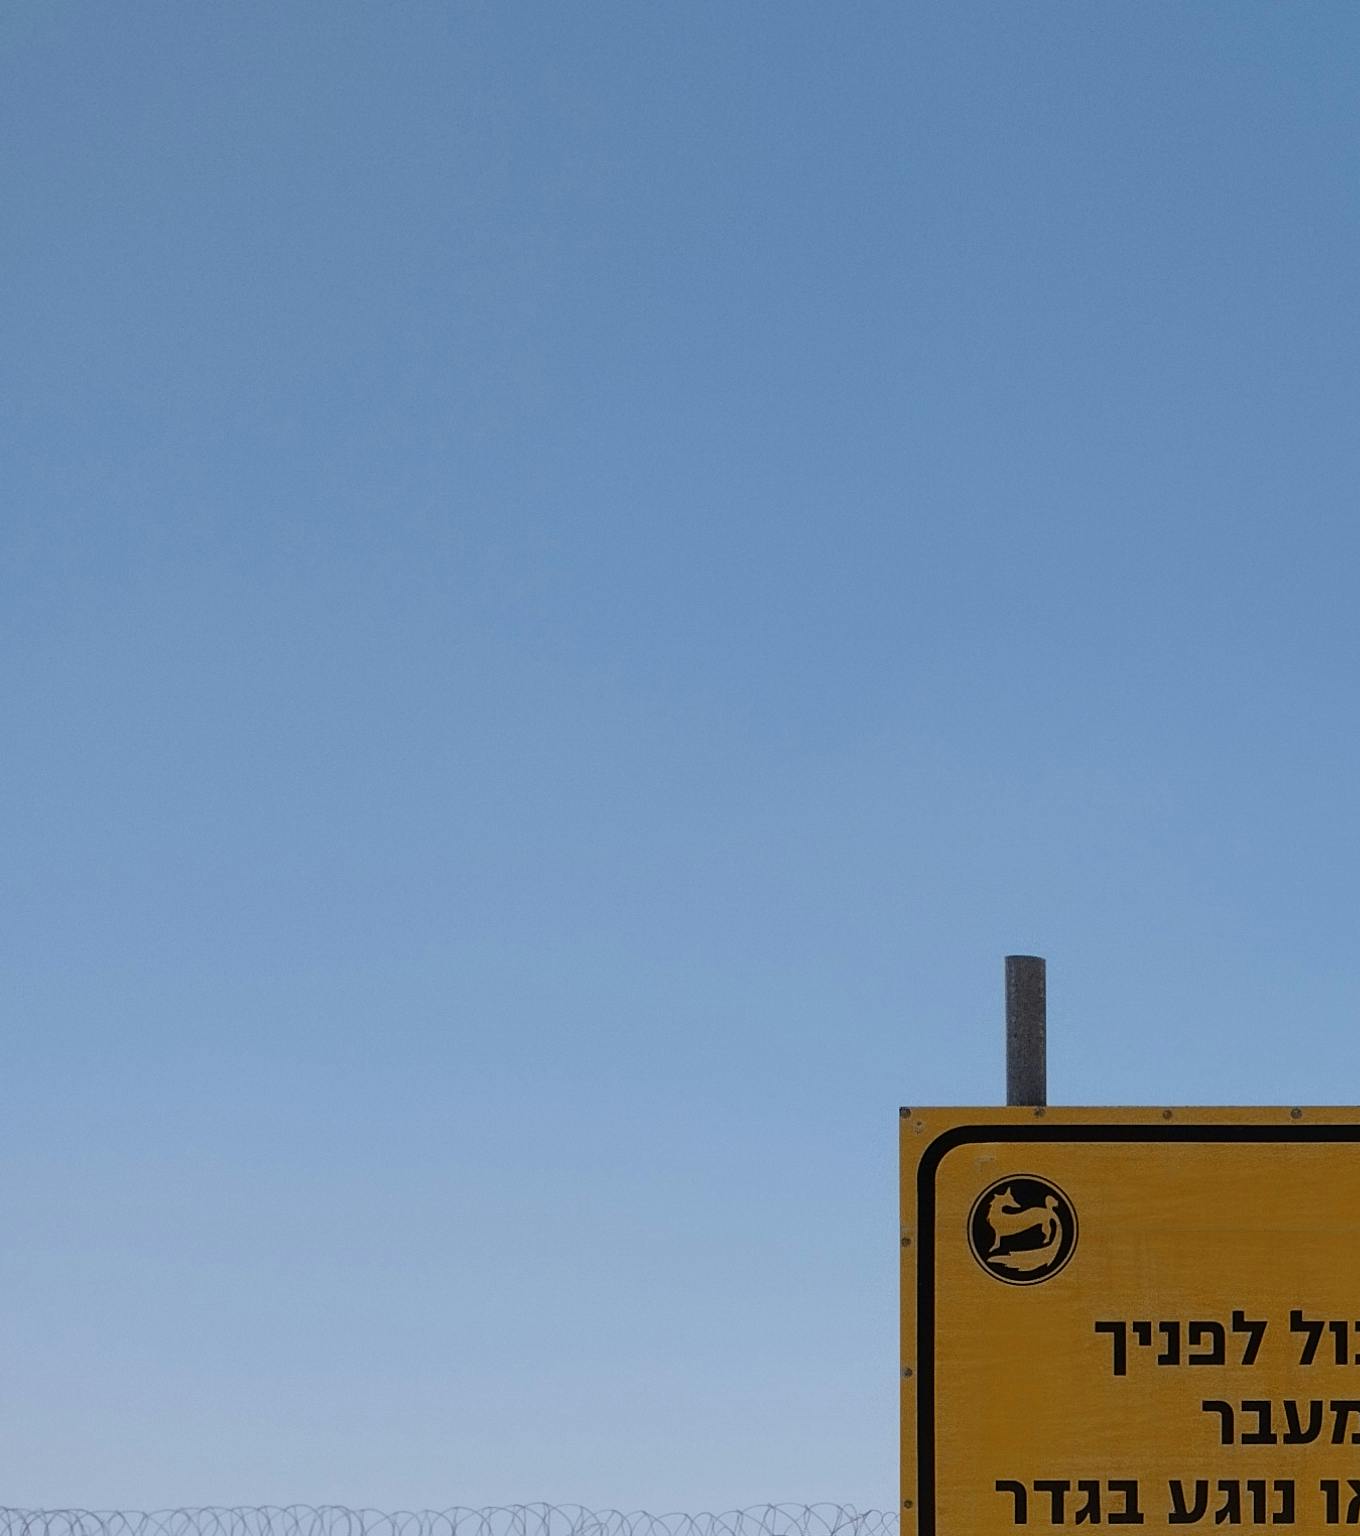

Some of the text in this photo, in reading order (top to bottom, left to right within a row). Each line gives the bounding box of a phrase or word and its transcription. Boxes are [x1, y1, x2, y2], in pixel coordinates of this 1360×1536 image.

[1094, 1310, 1268, 1376] לפניך
[995, 1479, 1145, 1526] בגדר
[1168, 1479, 1295, 1525] נוגע
